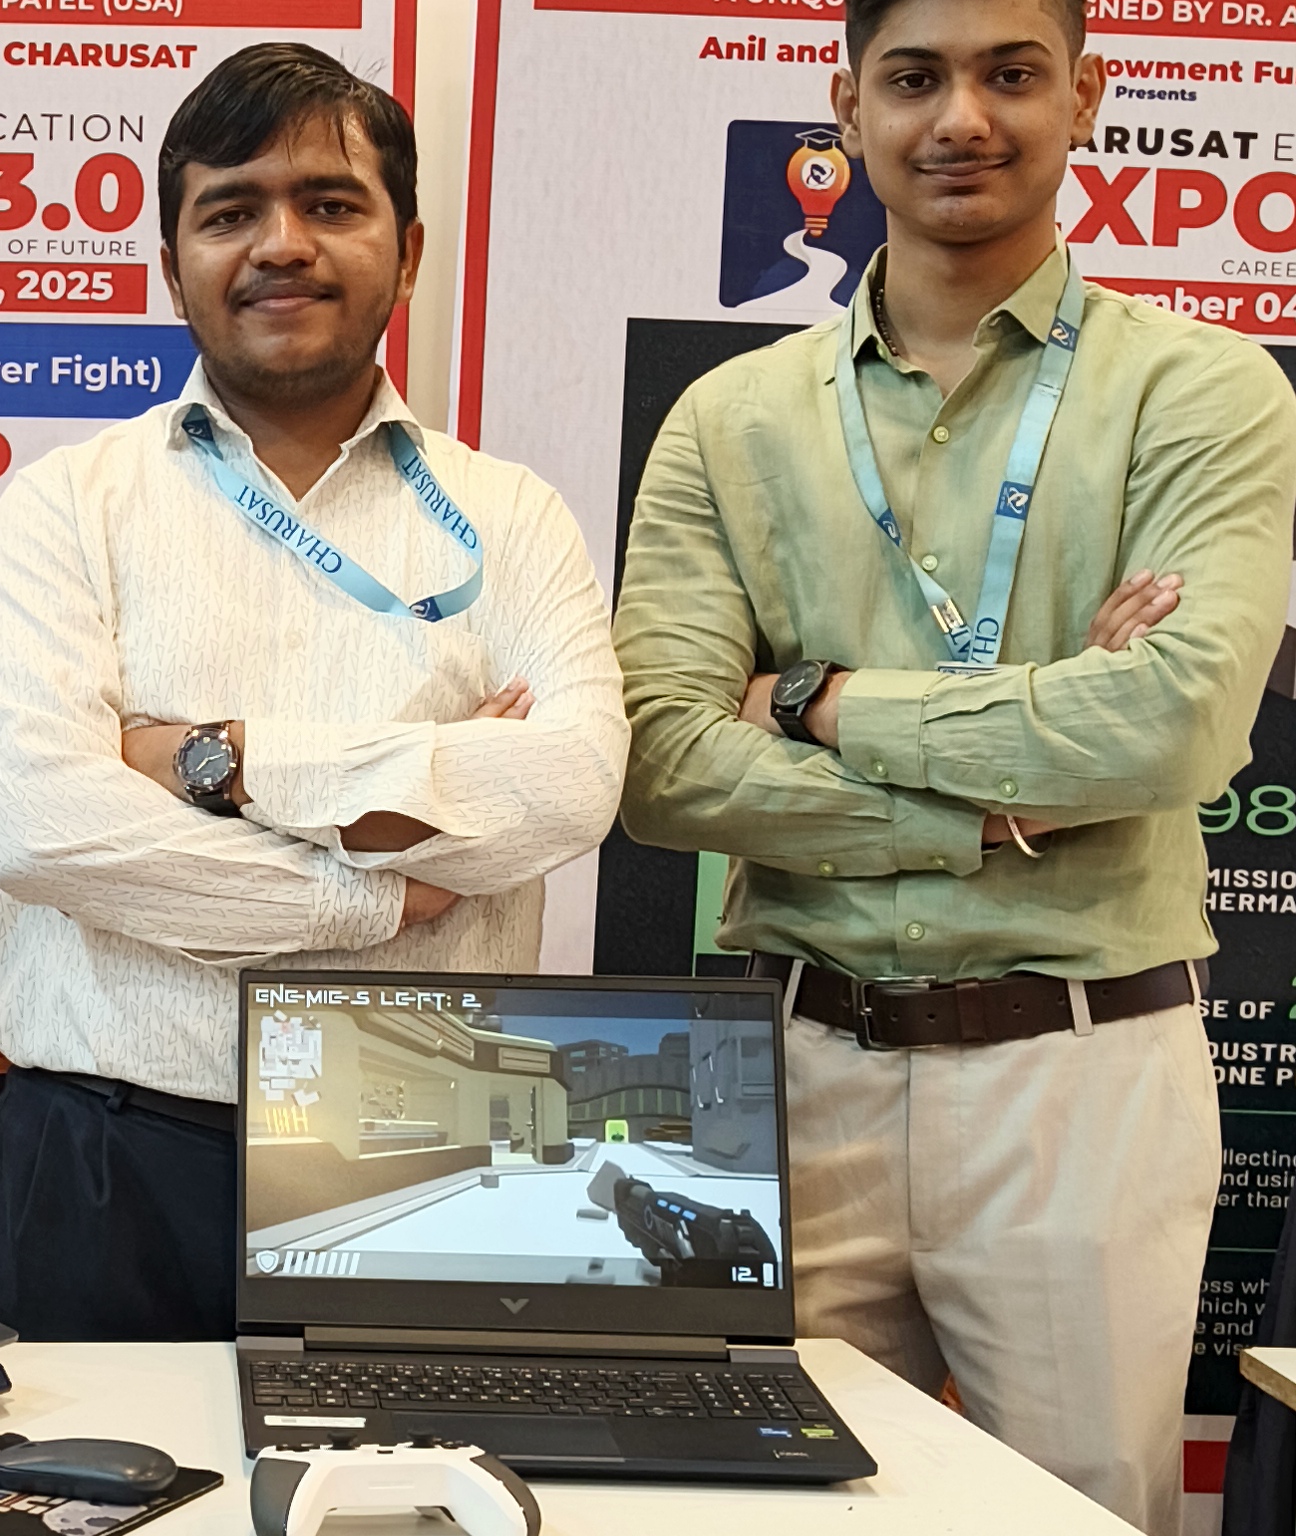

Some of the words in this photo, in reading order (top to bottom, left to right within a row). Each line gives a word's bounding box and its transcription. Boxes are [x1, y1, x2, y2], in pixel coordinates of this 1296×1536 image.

[1173, 0, 1214, 24] BY
[1221, 2, 1273, 27] DR.
[3, 41, 198, 69] CHARUSAT
[699, 35, 767, 62] Anil
[776, 40, 840, 64] and
[1115, 85, 1198, 102] Presents
[1056, 163, 1296, 254] XPO
[7, 238, 38, 255] OF
[47, 239, 137, 257] FUTURE
[16, 270, 114, 301] 2025
[51, 354, 162, 393] Fight)
[404, 455, 478, 551] CHARUSAT
[233, 484, 343, 575] CHARUSAT
[380, 991, 453, 1011] LEFT:
[461, 993, 482, 1008] 2
[1239, 1000, 1276, 1020] OF
[731, 1266, 758, 1282] 12
[1213, 1319, 1254, 1336] and
